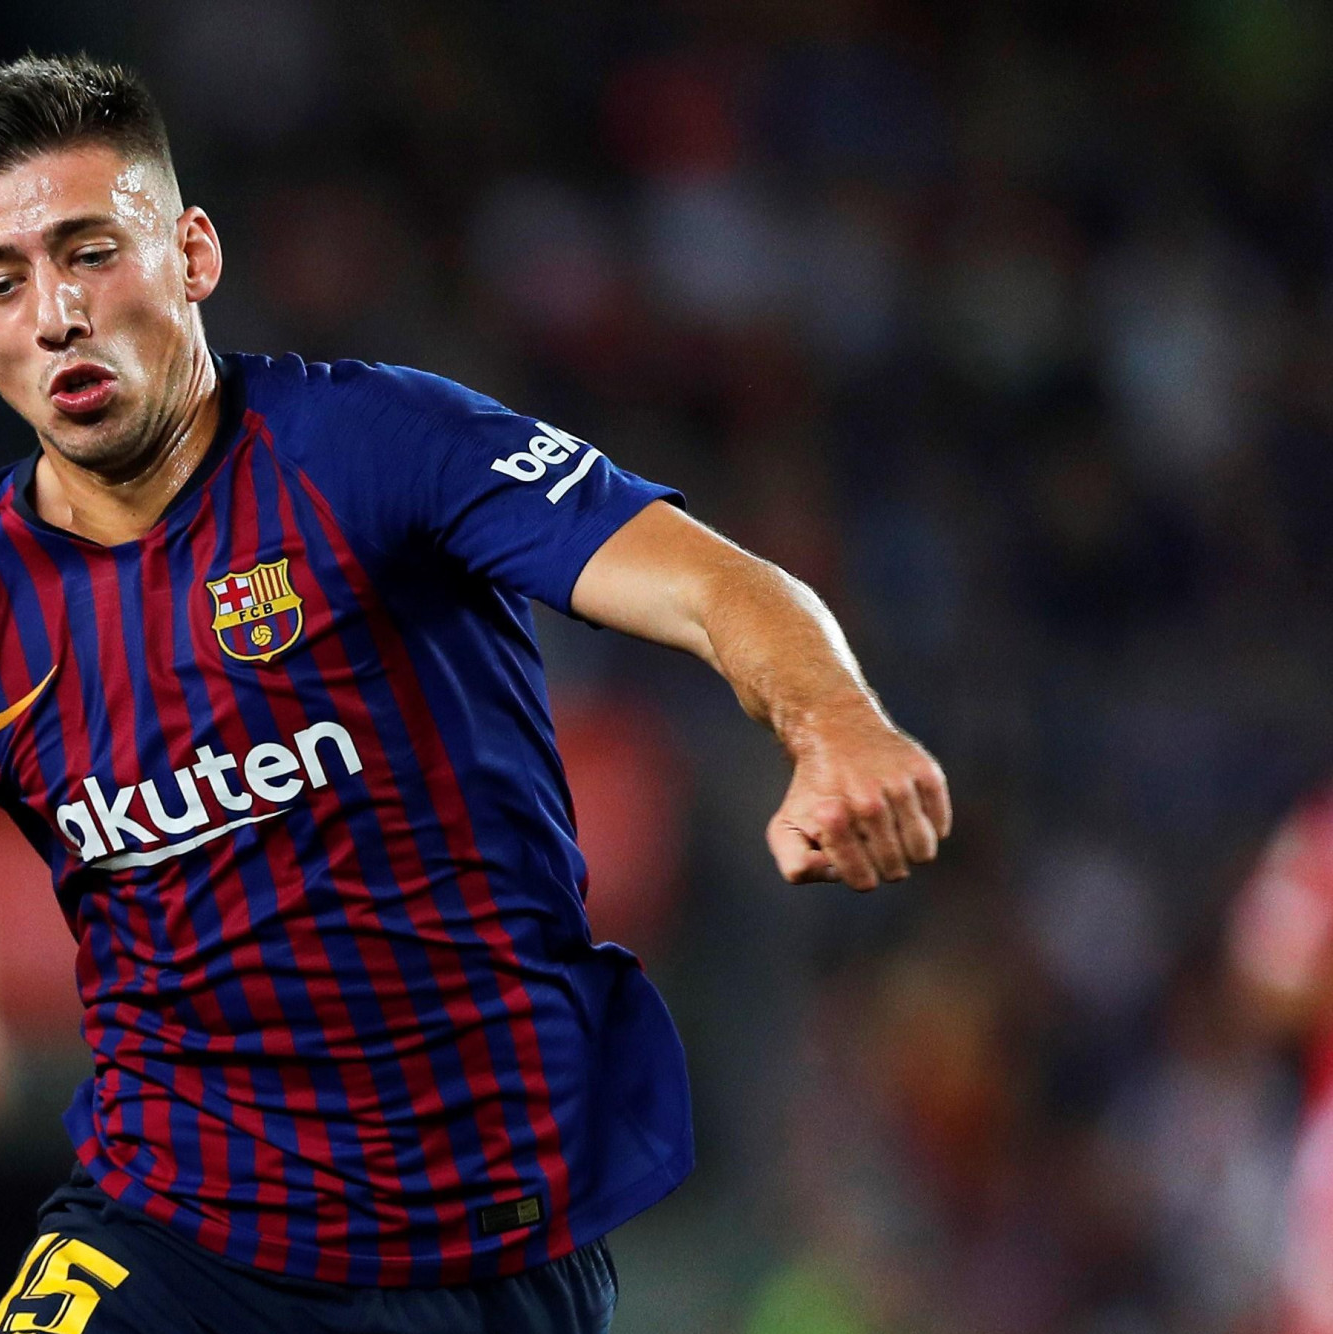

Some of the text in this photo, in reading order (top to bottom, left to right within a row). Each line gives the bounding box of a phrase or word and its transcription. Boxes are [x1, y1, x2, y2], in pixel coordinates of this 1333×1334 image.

[490, 421, 589, 482] bek
[239, 602, 274, 622] FCB
[56, 721, 363, 862] akuten
